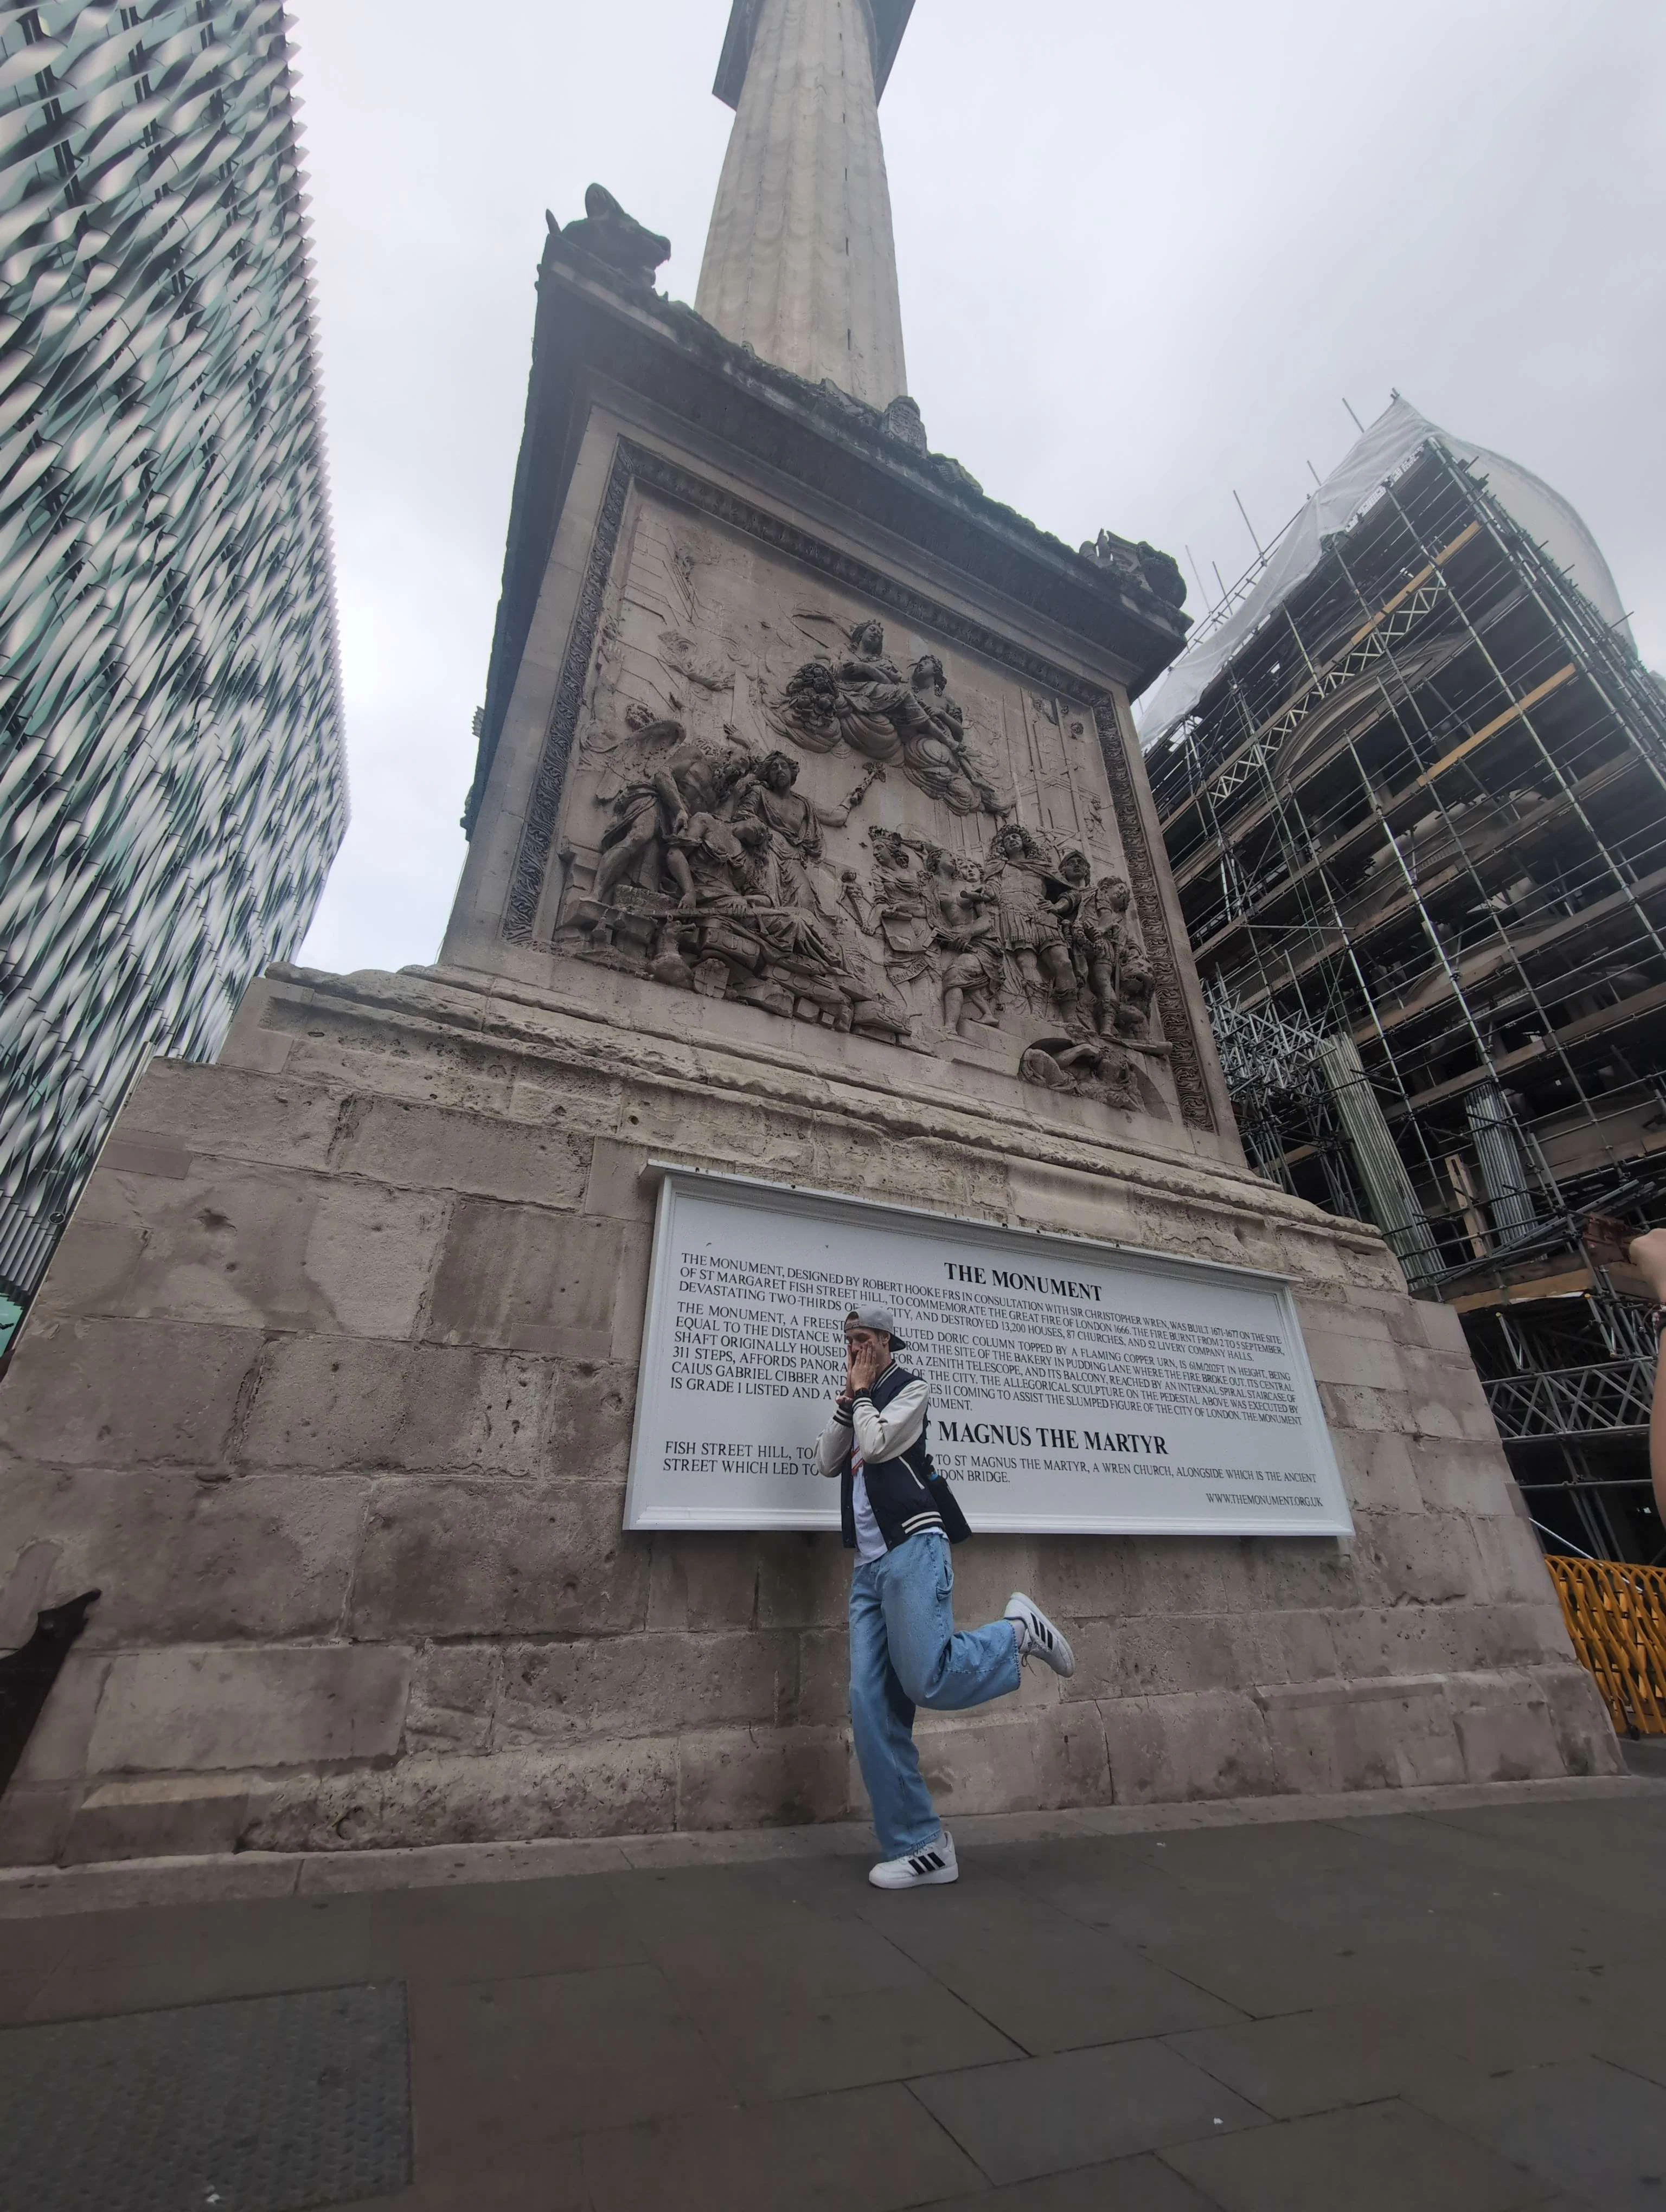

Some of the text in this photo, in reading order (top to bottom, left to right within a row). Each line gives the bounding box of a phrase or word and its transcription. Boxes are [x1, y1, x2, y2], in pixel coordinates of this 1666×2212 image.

[680, 1267, 696, 1277] OF
[700, 1269, 714, 1280] ST
[717, 1271, 786, 1289] MARGARET
[790, 1281, 813, 1294] FISH
[816, 1285, 857, 1299] STREET
[860, 1290, 887, 1304] HILL,
[889, 1294, 904, 1305] TO
[906, 1297, 986, 1315] COMMEMORATE
[988, 1308, 1007, 1318] THE
[1009, 1310, 1039, 1322] GREAT
[1041, 1315, 1061, 1325] FIRE
[1075, 1319, 1112, 1332] LONDON
[1132, 1327, 1149, 1337] THE
[1150, 1329, 1168, 1339] FIRE
[1169, 1332, 1195, 1342] BURNT
[1197, 1336, 1219, 1346] FROM
[682, 1253, 707, 1265] THE
[710, 1257, 784, 1278] MONUMENT,
[787, 1268, 843, 1284] DESIGNED
[845, 1276, 860, 1286] BY
[863, 1278, 902, 1292] ROBERT
[905, 1284, 940, 1297] HOOKE
[943, 1289, 960, 1300] FRS
[962, 1292, 972, 1301] IN
[974, 1294, 1043, 1310] CONSULTATION
[1045, 1303, 1069, 1315] WITH
[1070, 1307, 1084, 1317] SIR
[1085, 1309, 1142, 1324] CHRISTOPHER
[1169, 1321, 1187, 1331] WAS
[1187, 1323, 1208, 1334] BUILT
[1266, 1335, 1281, 1344] SITE
[944, 1262, 1101, 1301] THE MONUMENT
[677, 1301, 703, 1314] THE
[709, 1306, 785, 1326] MONUMENT,
[893, 1326, 934, 1340] FLUTED
[938, 1332, 969, 1344] DORIC
[972, 1336, 1015, 1349] COLUMN
[1018, 1341, 1053, 1353] TOPPED
[1055, 1345, 1066, 1355] BY
[1080, 1348, 1120, 1361] FLAMING
[1124, 1353, 1155, 1365] COPPER
[1268, 1371, 1291, 1381] BEING
[679, 1281, 765, 1301] DEVASTATING
[769, 1292, 841, 1310] TWO-THIRDS
[915, 1311, 938, 1322] AND
[941, 1314, 998, 1329] DESTROYED
[1002, 1321, 1026, 1333] 13,200
[1028, 1325, 1065, 1339] HOUSES,
[1066, 1329, 1074, 1339] 87
[1128, 1338, 1146, 1347] AND
[1148, 1340, 1156, 1349] 52
[1157, 1341, 1185, 1353] LIVERY
[1188, 1345, 1225, 1358] COMPANY
[673, 1346, 1287, 1412] 311 STEPS, AFFORDS THE CITY. THE ALLEGORICAL SCULPTURE PEDESTAL ABOVE WAS EXECUTED
[675, 1331, 717, 1345] SHAFT
[721, 1335, 796, 1353] ORIGINALLY
[800, 1343, 846, 1357] HOUSED
[893, 1353, 914, 1365] FOR
[926, 1356, 963, 1369] ZENITH
[965, 1360, 1023, 1377] TELESCOPE,
[1025, 1366, 1046, 1377] AND
[1048, 1368, 1061, 1379] ITS
[1109, 1375, 1150, 1387] REACHED
[1177, 1382, 1219, 1394] INTERNAL
[1219, 1387, 1247, 1397] SPIRAL
[1247, 1390, 1286, 1401] STAIRCASE
[676, 1316, 720, 1330] EQUAL
[723, 1321, 740, 1333] TO
[744, 1323, 768, 1336] THE
[772, 1327, 829, 1342] DISTANCE
[904, 1340, 929, 1353] ROM
[932, 1343, 952, 1355] THE
[954, 1346, 976, 1357] SITE
[978, 1349, 990, 1359] OF
[1014, 1353, 1052, 1365] BAKERY
[1054, 1357, 1064, 1366] IN
[1066, 1359, 1106, 1371] PUDDING
[1107, 1363, 1131, 1374] LANE
[1132, 1366, 1164, 1377] WHERE
[1164, 1369, 1182, 1379] THE
[1182, 1372, 1201, 1381] FIRE
[1201, 1374, 1228, 1384] BROKE
[1259, 1380, 1294, 1392] CENTRAL
[671, 1377, 819, 1398] IS GRADE LISTED AND
[672, 1361, 712, 1375] CAIUS
[716, 1365, 772, 1380] GABRIEL
[775, 1370, 819, 1384] CIBBER
[822, 1374, 847, 1386] AND
[953, 1386, 995, 1399] COMING
[998, 1390, 1010, 1400] TO
[1013, 1391, 1043, 1403] ASSIST
[1046, 1394, 1065, 1404] THE
[1066, 1396, 1108, 1408] SLUMPED
[1110, 1400, 1142, 1411] FIGURE
[1174, 1405, 1192, 1415] CITY
[1258, 1413, 1302, 1425] MONUMENT
[665, 1441, 696, 1454] FISH
[701, 1443, 753, 1456] STREET
[758, 1445, 791, 1460] HILL,
[797, 1447, 813, 1459] TO
[935, 1454, 951, 1465] TO
[954, 1455, 967, 1466] ST
[971, 1456, 1017, 1468] MAGNUS
[1020, 1458, 1041, 1469] THE
[1043, 1459, 1090, 1473] MARTYR,
[1102, 1463, 1130, 1474] WREN
[1176, 1467, 1223, 1478] ALONGSIDE
[1225, 1469, 1254, 1480] WHICH
[1255, 1471, 1264, 1480] IS
[1264, 1471, 1281, 1481] THE
[1284, 1472, 1316, 1482] ANCIENT
[938, 1420, 1031, 1446] MAGNUS
[1036, 1427, 1078, 1449] THE
[1083, 1431, 1169, 1454] MARTYR
[663, 1458, 717, 1472] STREET
[722, 1461, 767, 1474] WHICH
[773, 1462, 798, 1475] LED
[802, 1463, 819, 1476] TO
[967, 1470, 1010, 1482] BRIDGE.
[1206, 1493, 1323, 1507] WWW.THEMONUMENT.ORG.UK
